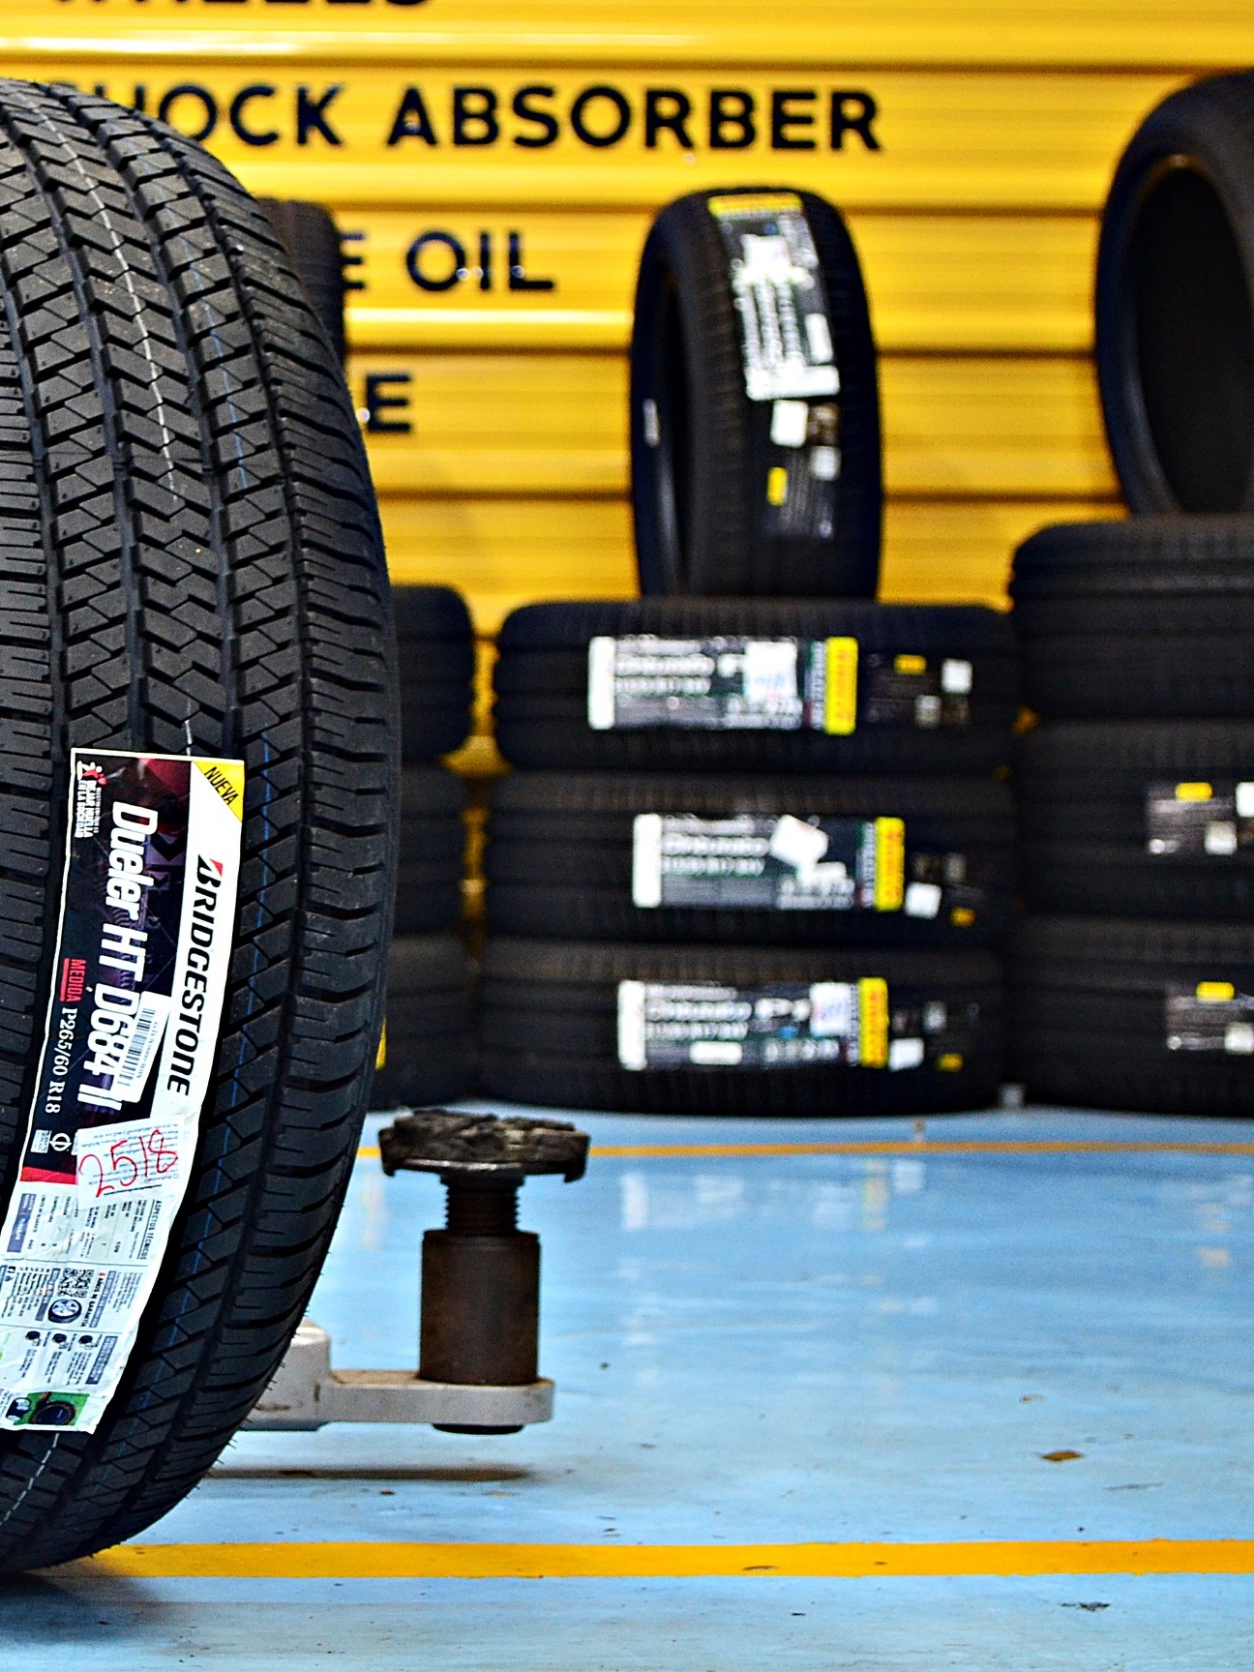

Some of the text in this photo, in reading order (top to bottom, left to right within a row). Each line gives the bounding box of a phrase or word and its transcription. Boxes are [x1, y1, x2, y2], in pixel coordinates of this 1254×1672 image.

[50, 80, 881, 151] OCK ABSORBER
[405, 231, 554, 293] OIL
[203, 765, 241, 807] NUEVA
[105, 801, 158, 920] Dueler
[66, 959, 87, 1002] MEDIDA
[99, 923, 147, 982] HT
[167, 853, 224, 1096] BRIDGESTONE
[83, 982, 141, 1077] D684
[78, 1129, 179, 1198] 2518
